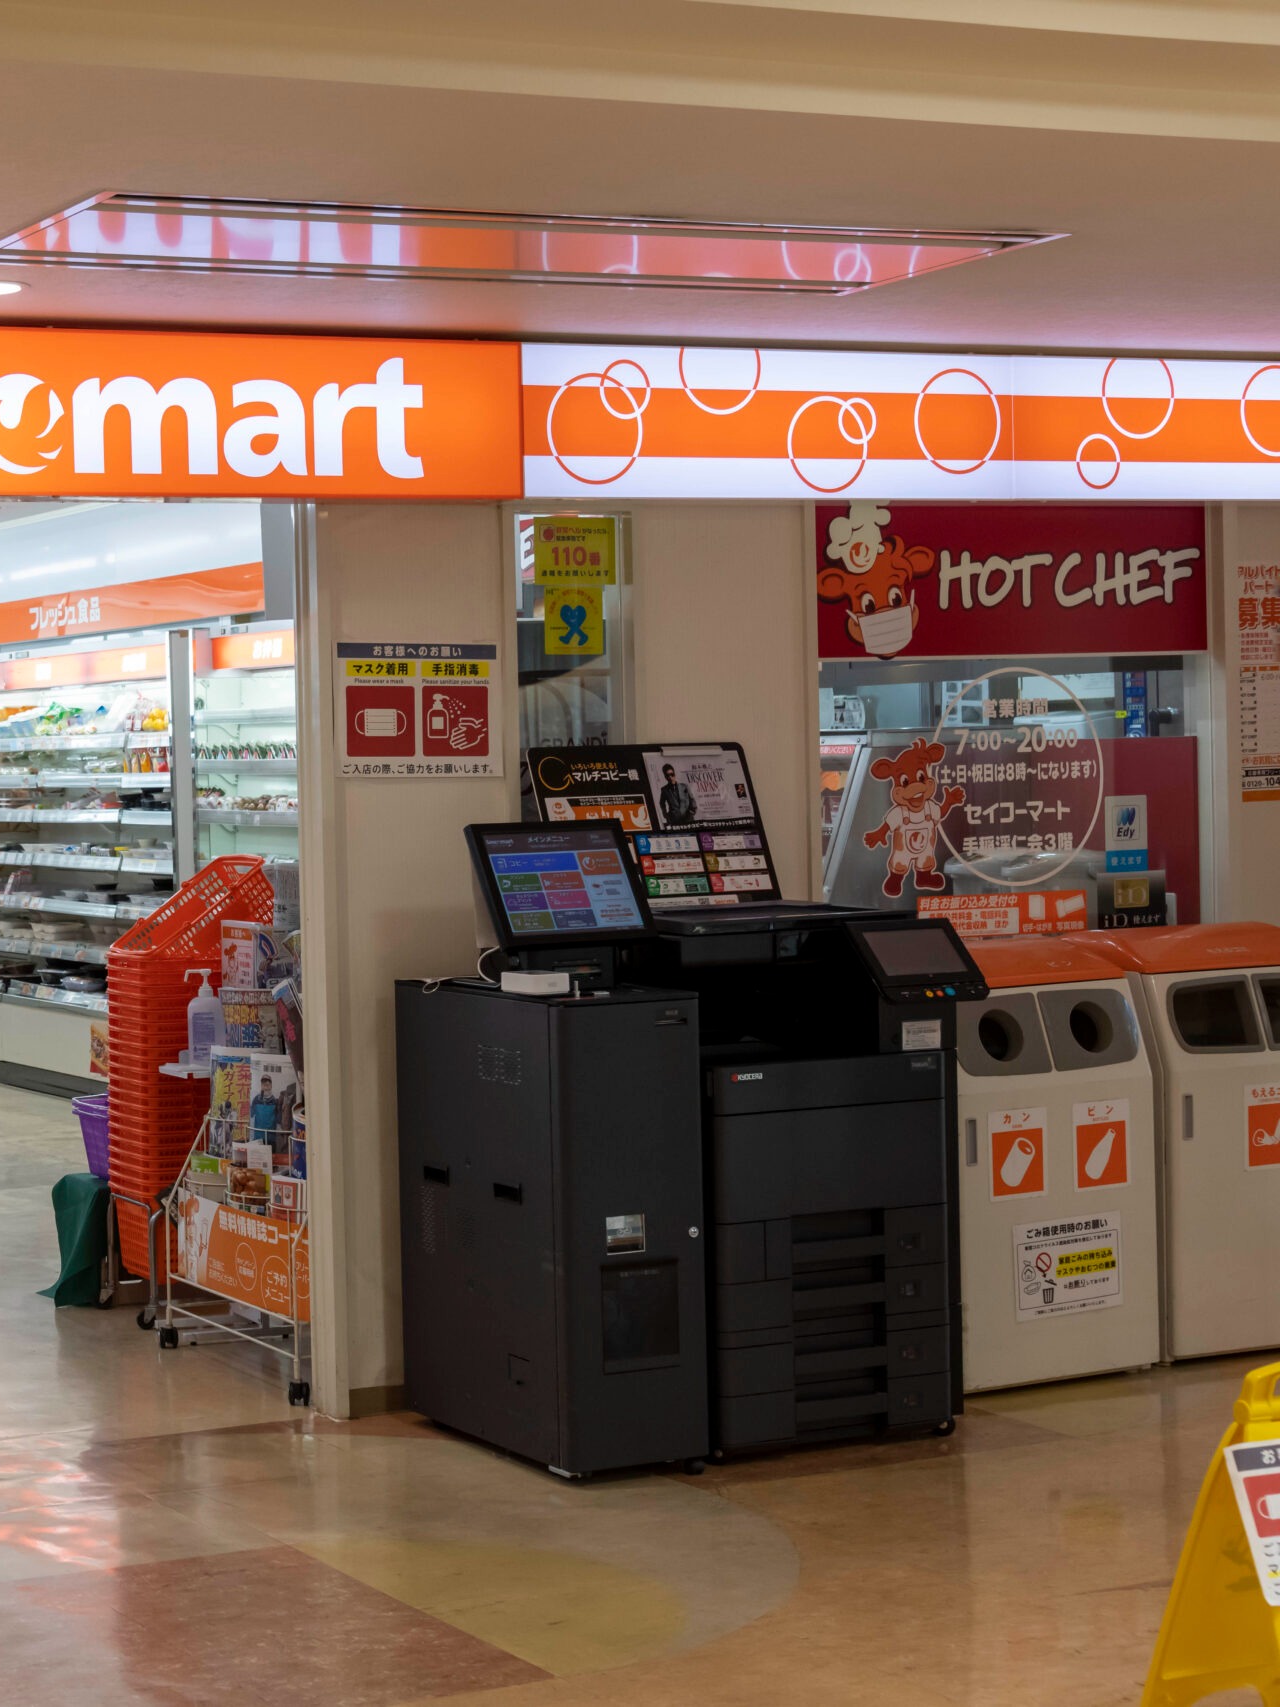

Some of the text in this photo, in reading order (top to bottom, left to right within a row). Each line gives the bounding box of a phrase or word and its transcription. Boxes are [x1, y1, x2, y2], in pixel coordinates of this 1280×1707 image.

[551, 547, 601, 566] 110番
[939, 547, 1200, 610] HOT CHEF
[1244, 581, 1273, 594] パート
[29, 596, 101, 630] フレッシュ食品
[373, 645, 461, 657] お客様へのお願い
[353, 663, 408, 675] マスク着用
[432, 664, 479, 676] 手指消毒
[982, 699, 1048, 718] 営業時間
[342, 764, 493, 775] ご入店の際、ご協力をお願いします。
[571, 762, 617, 770] いろいろ使える!
[572, 769, 639, 782] マルチコピー機
[696, 782, 719, 792] JAPAN
[964, 801, 1070, 824] セイコーマート
[1116, 827, 1135, 838] Edy
[1111, 856, 1142, 866] 使えます
[920, 896, 1018, 910] 料金お振り込み受付中
[1104, 913, 1160, 928] iD 使えます
[1023, 923, 1052, 932] 切手・はがき
[737, 1072, 763, 1081] KYOCERA
[1088, 1105, 1114, 1117] ビン
[1003, 1112, 1031, 1125] カン
[1026, 1218, 1108, 1239] ごみ箱使用時のお願い
